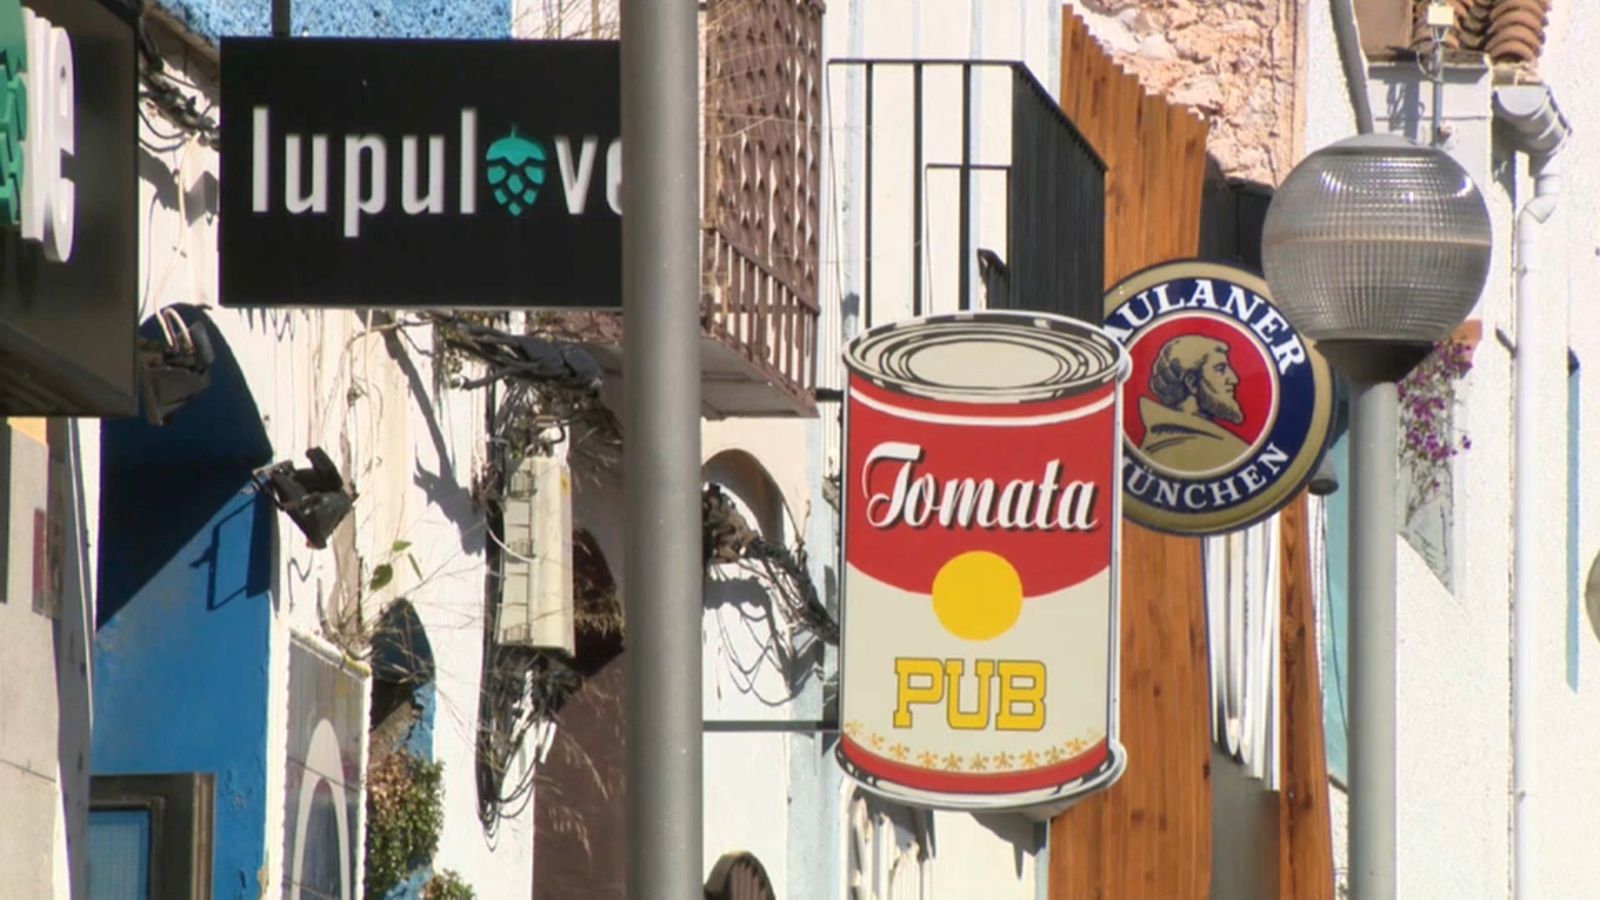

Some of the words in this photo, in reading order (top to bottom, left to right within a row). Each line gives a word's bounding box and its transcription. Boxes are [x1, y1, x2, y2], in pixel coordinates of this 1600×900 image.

[1103, 279, 1305, 375] AULANER
[861, 440, 1100, 531] Tomata
[1122, 441, 1290, 509] ÜNCHEN
[893, 657, 1047, 732] PUB
